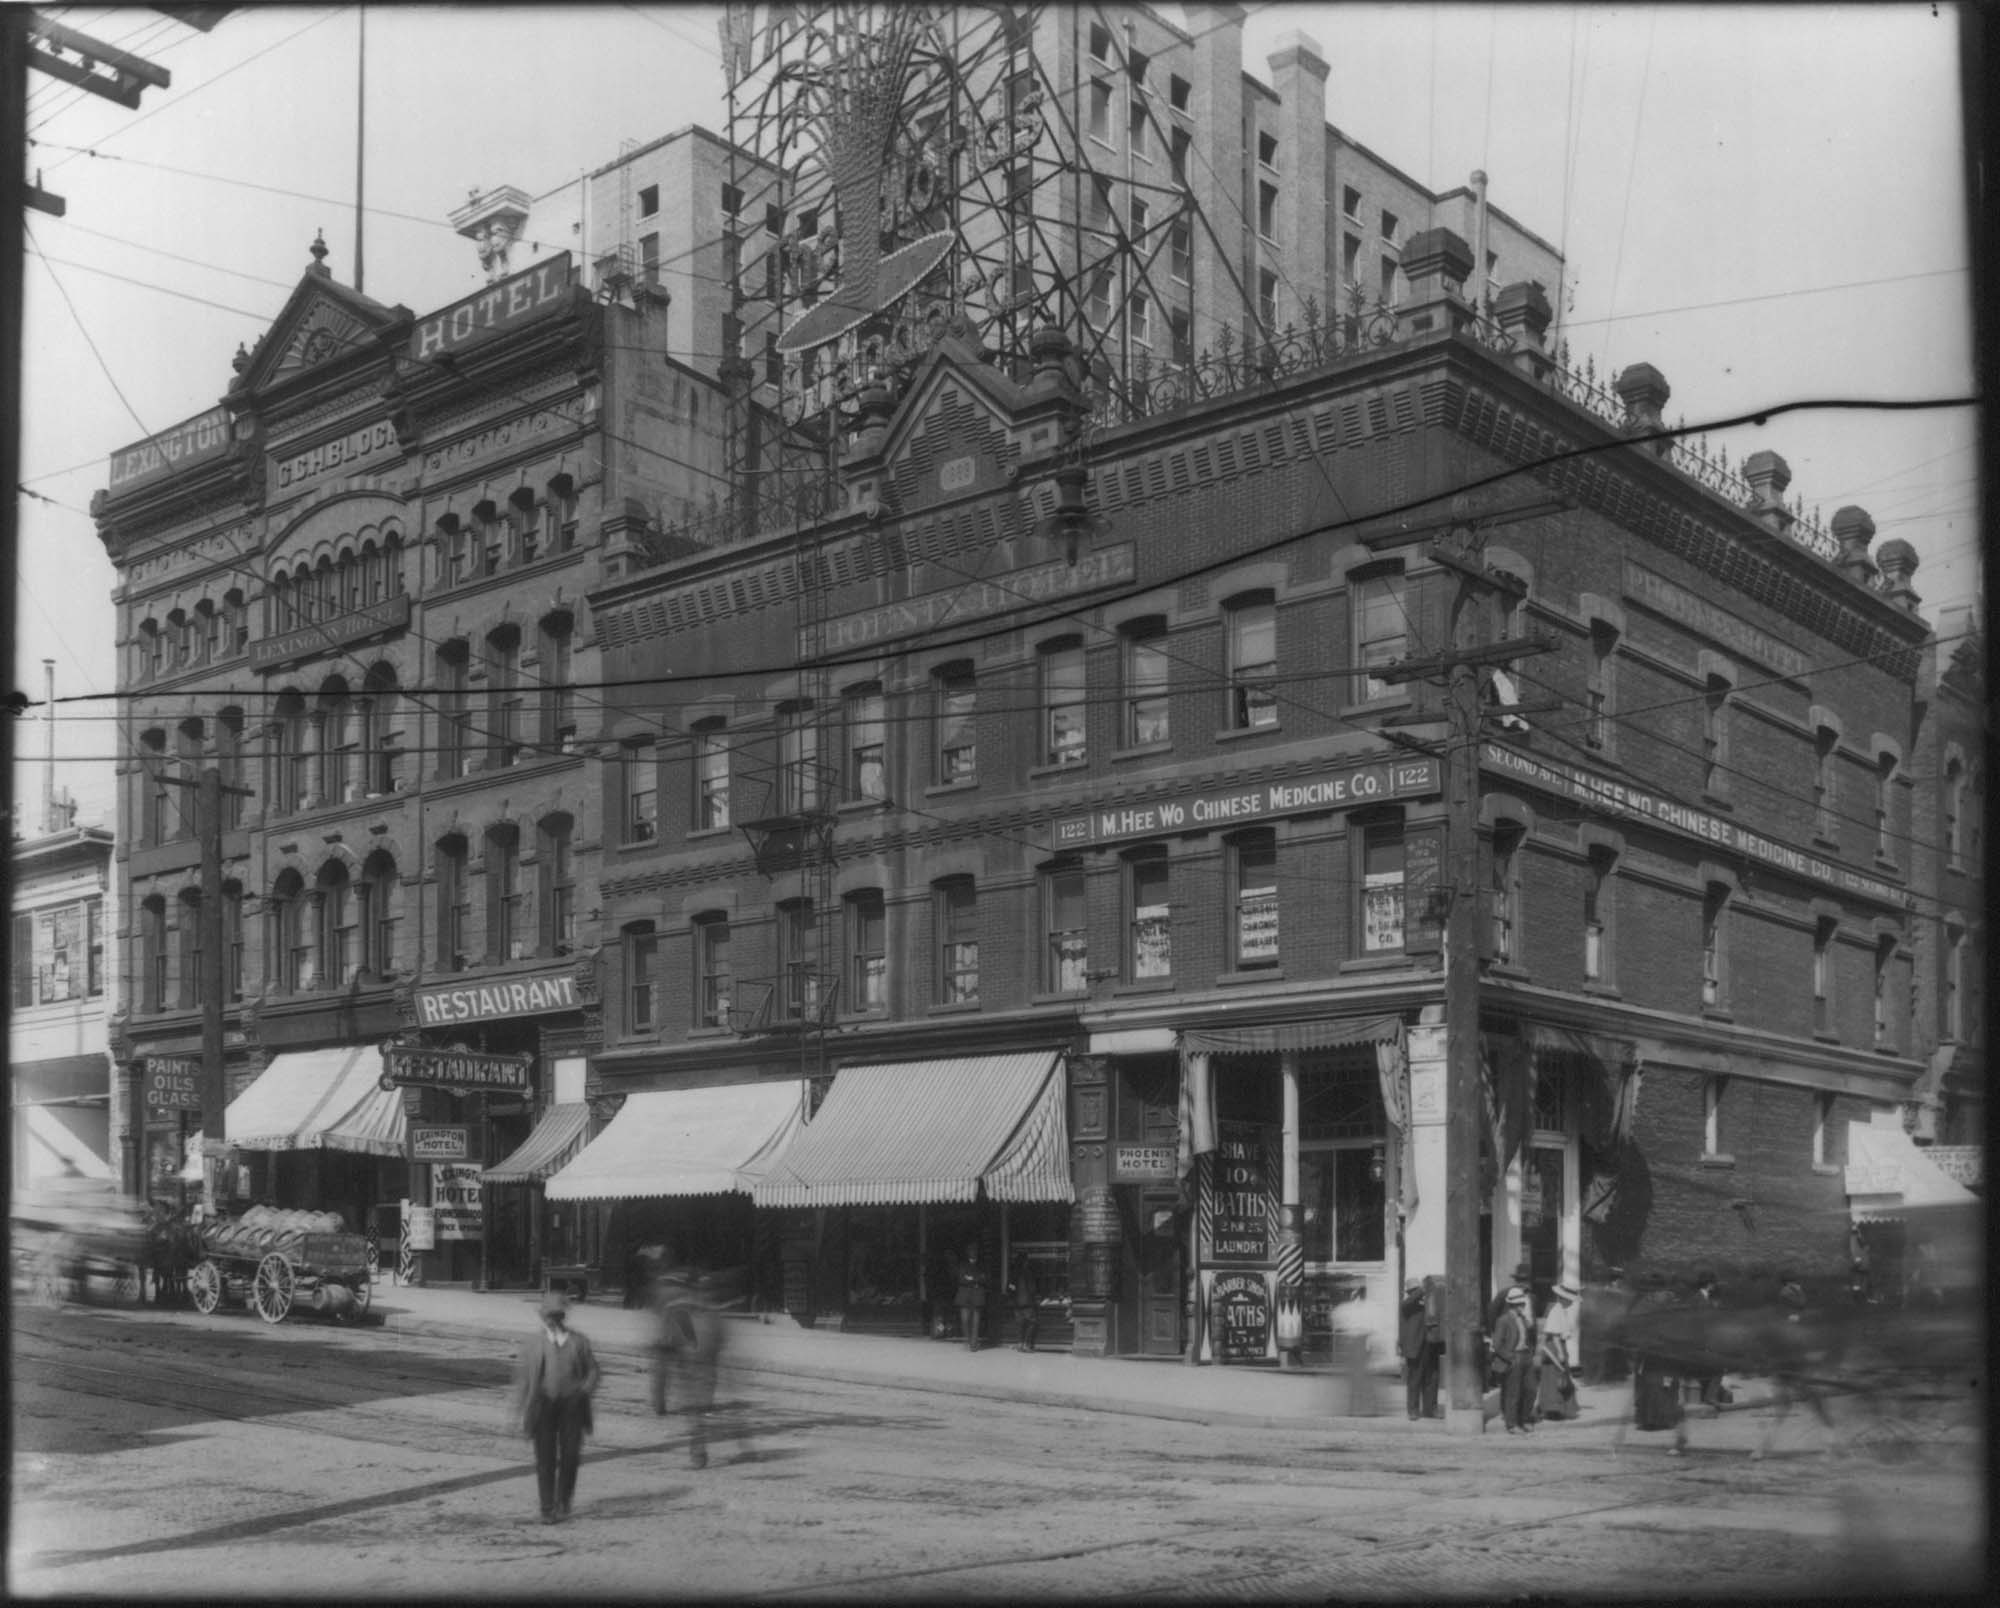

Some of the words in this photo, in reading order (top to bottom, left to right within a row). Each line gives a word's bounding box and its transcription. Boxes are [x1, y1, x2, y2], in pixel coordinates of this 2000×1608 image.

[418, 267, 560, 359] HOTEL
[111, 411, 227, 486] LEXINGTON
[1059, 820, 1086, 840] 122
[1101, 811, 1155, 837] M.HEE
[1192, 794, 1261, 822] CHINESE
[1269, 780, 1346, 809] MEDICINE
[1399, 767, 1430, 787] 122
[1488, 744, 1537, 776] SECOND
[1657, 802, 1732, 845] CHINESE
[1737, 830, 1805, 872] MEDICINE
[421, 976, 574, 1023] RESTAURANT
[146, 1058, 200, 1076] PAINTS
[153, 1074, 194, 1091] OILS
[146, 1089, 200, 1106] GLASS
[414, 1129, 465, 1145] LEXINGTON
[423, 1140, 458, 1150] HOTEL
[1119, 1149, 1171, 1158] PHOENIX
[1221, 1142, 1260, 1160] SHAVE
[1122, 1159, 1167, 1169] HOTEL
[1214, 1191, 1267, 1217] BATHS
[1215, 1239, 1265, 1254] LAUNDRY
[1226, 1304, 1266, 1328] ATHS
